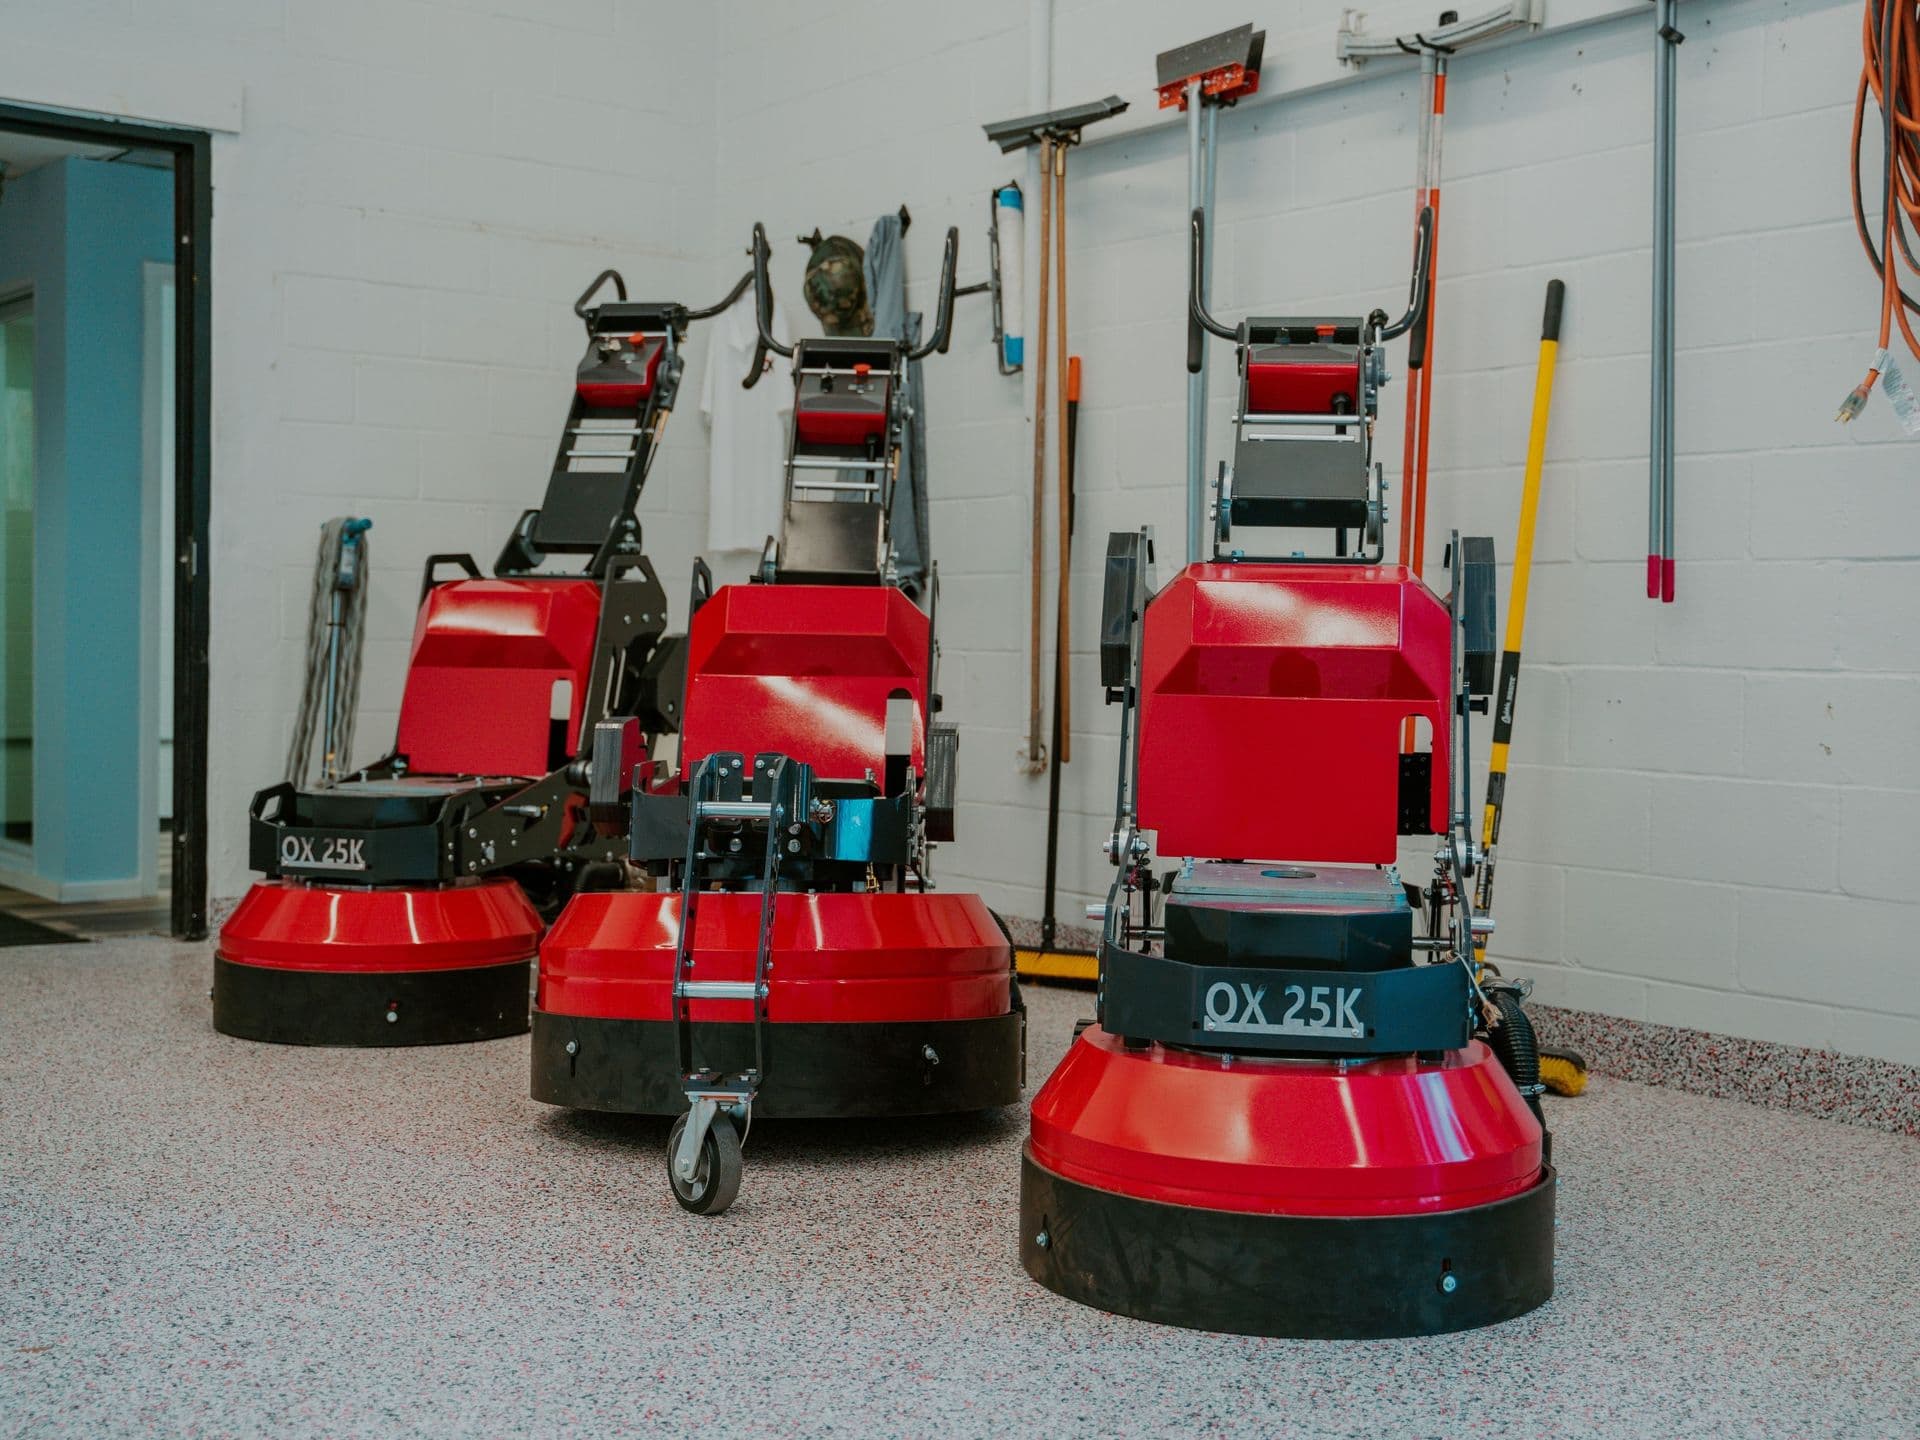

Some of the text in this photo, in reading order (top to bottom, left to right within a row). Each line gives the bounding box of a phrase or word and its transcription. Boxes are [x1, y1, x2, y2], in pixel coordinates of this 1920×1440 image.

[281, 835, 366, 865] OX 25K
[1205, 981, 1363, 1030] OX 25K
